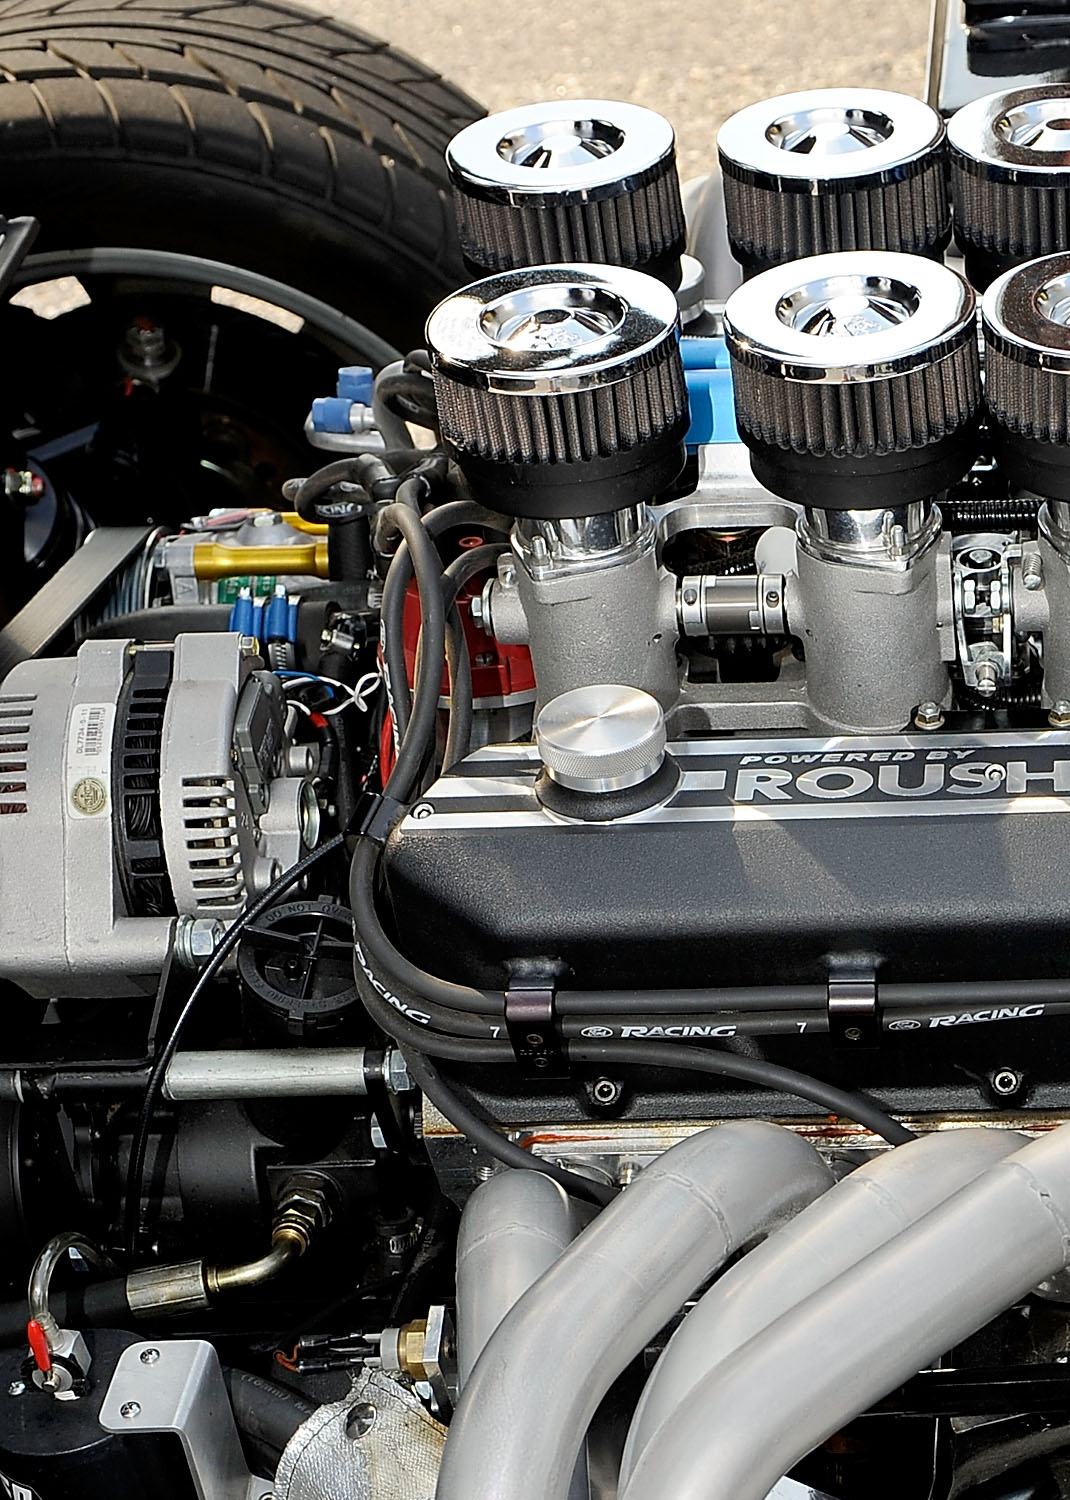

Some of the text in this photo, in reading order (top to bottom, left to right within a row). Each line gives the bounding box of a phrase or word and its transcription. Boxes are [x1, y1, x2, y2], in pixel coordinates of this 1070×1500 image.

[740, 749, 977, 765] POWERED BY
[265, 911, 282, 922] DO
[288, 904, 312, 913] NOT
[929, 1004, 1046, 1028] RACING
[490, 1026, 500, 1038] 7
[621, 1025, 737, 1038] RACING
[797, 1022, 807, 1033] 7
